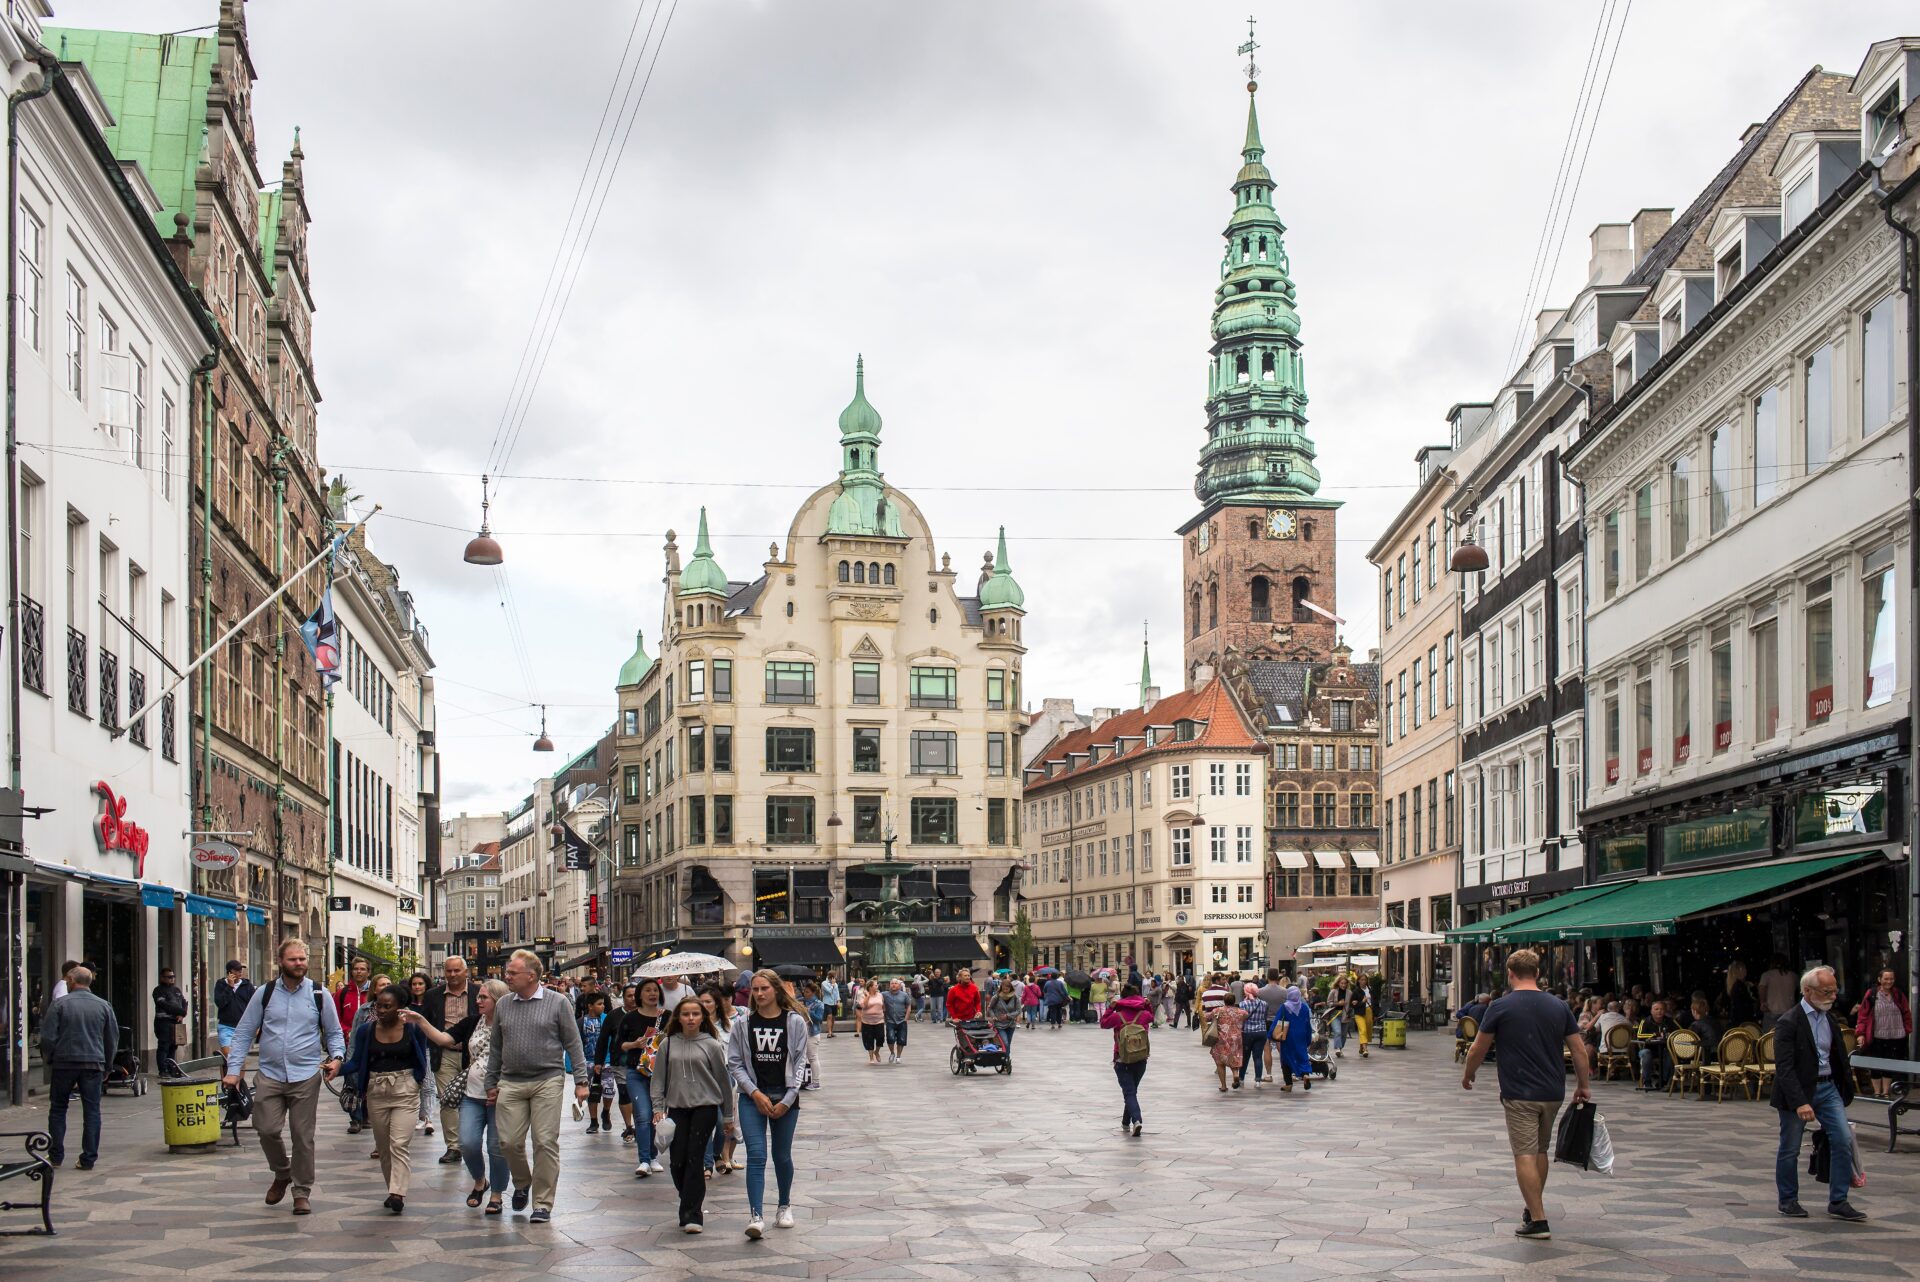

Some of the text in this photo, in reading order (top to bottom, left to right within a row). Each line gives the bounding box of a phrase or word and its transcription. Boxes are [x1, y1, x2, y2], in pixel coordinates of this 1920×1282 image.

[1719, 731, 1732, 745] 100
[1680, 831, 1696, 853] THE
[567, 843, 579, 869] HAY
[1204, 912, 1263, 921] ESPRESSO HOUSE
[176, 1103, 205, 1114] REN
[177, 1116, 206, 1127] KBH
